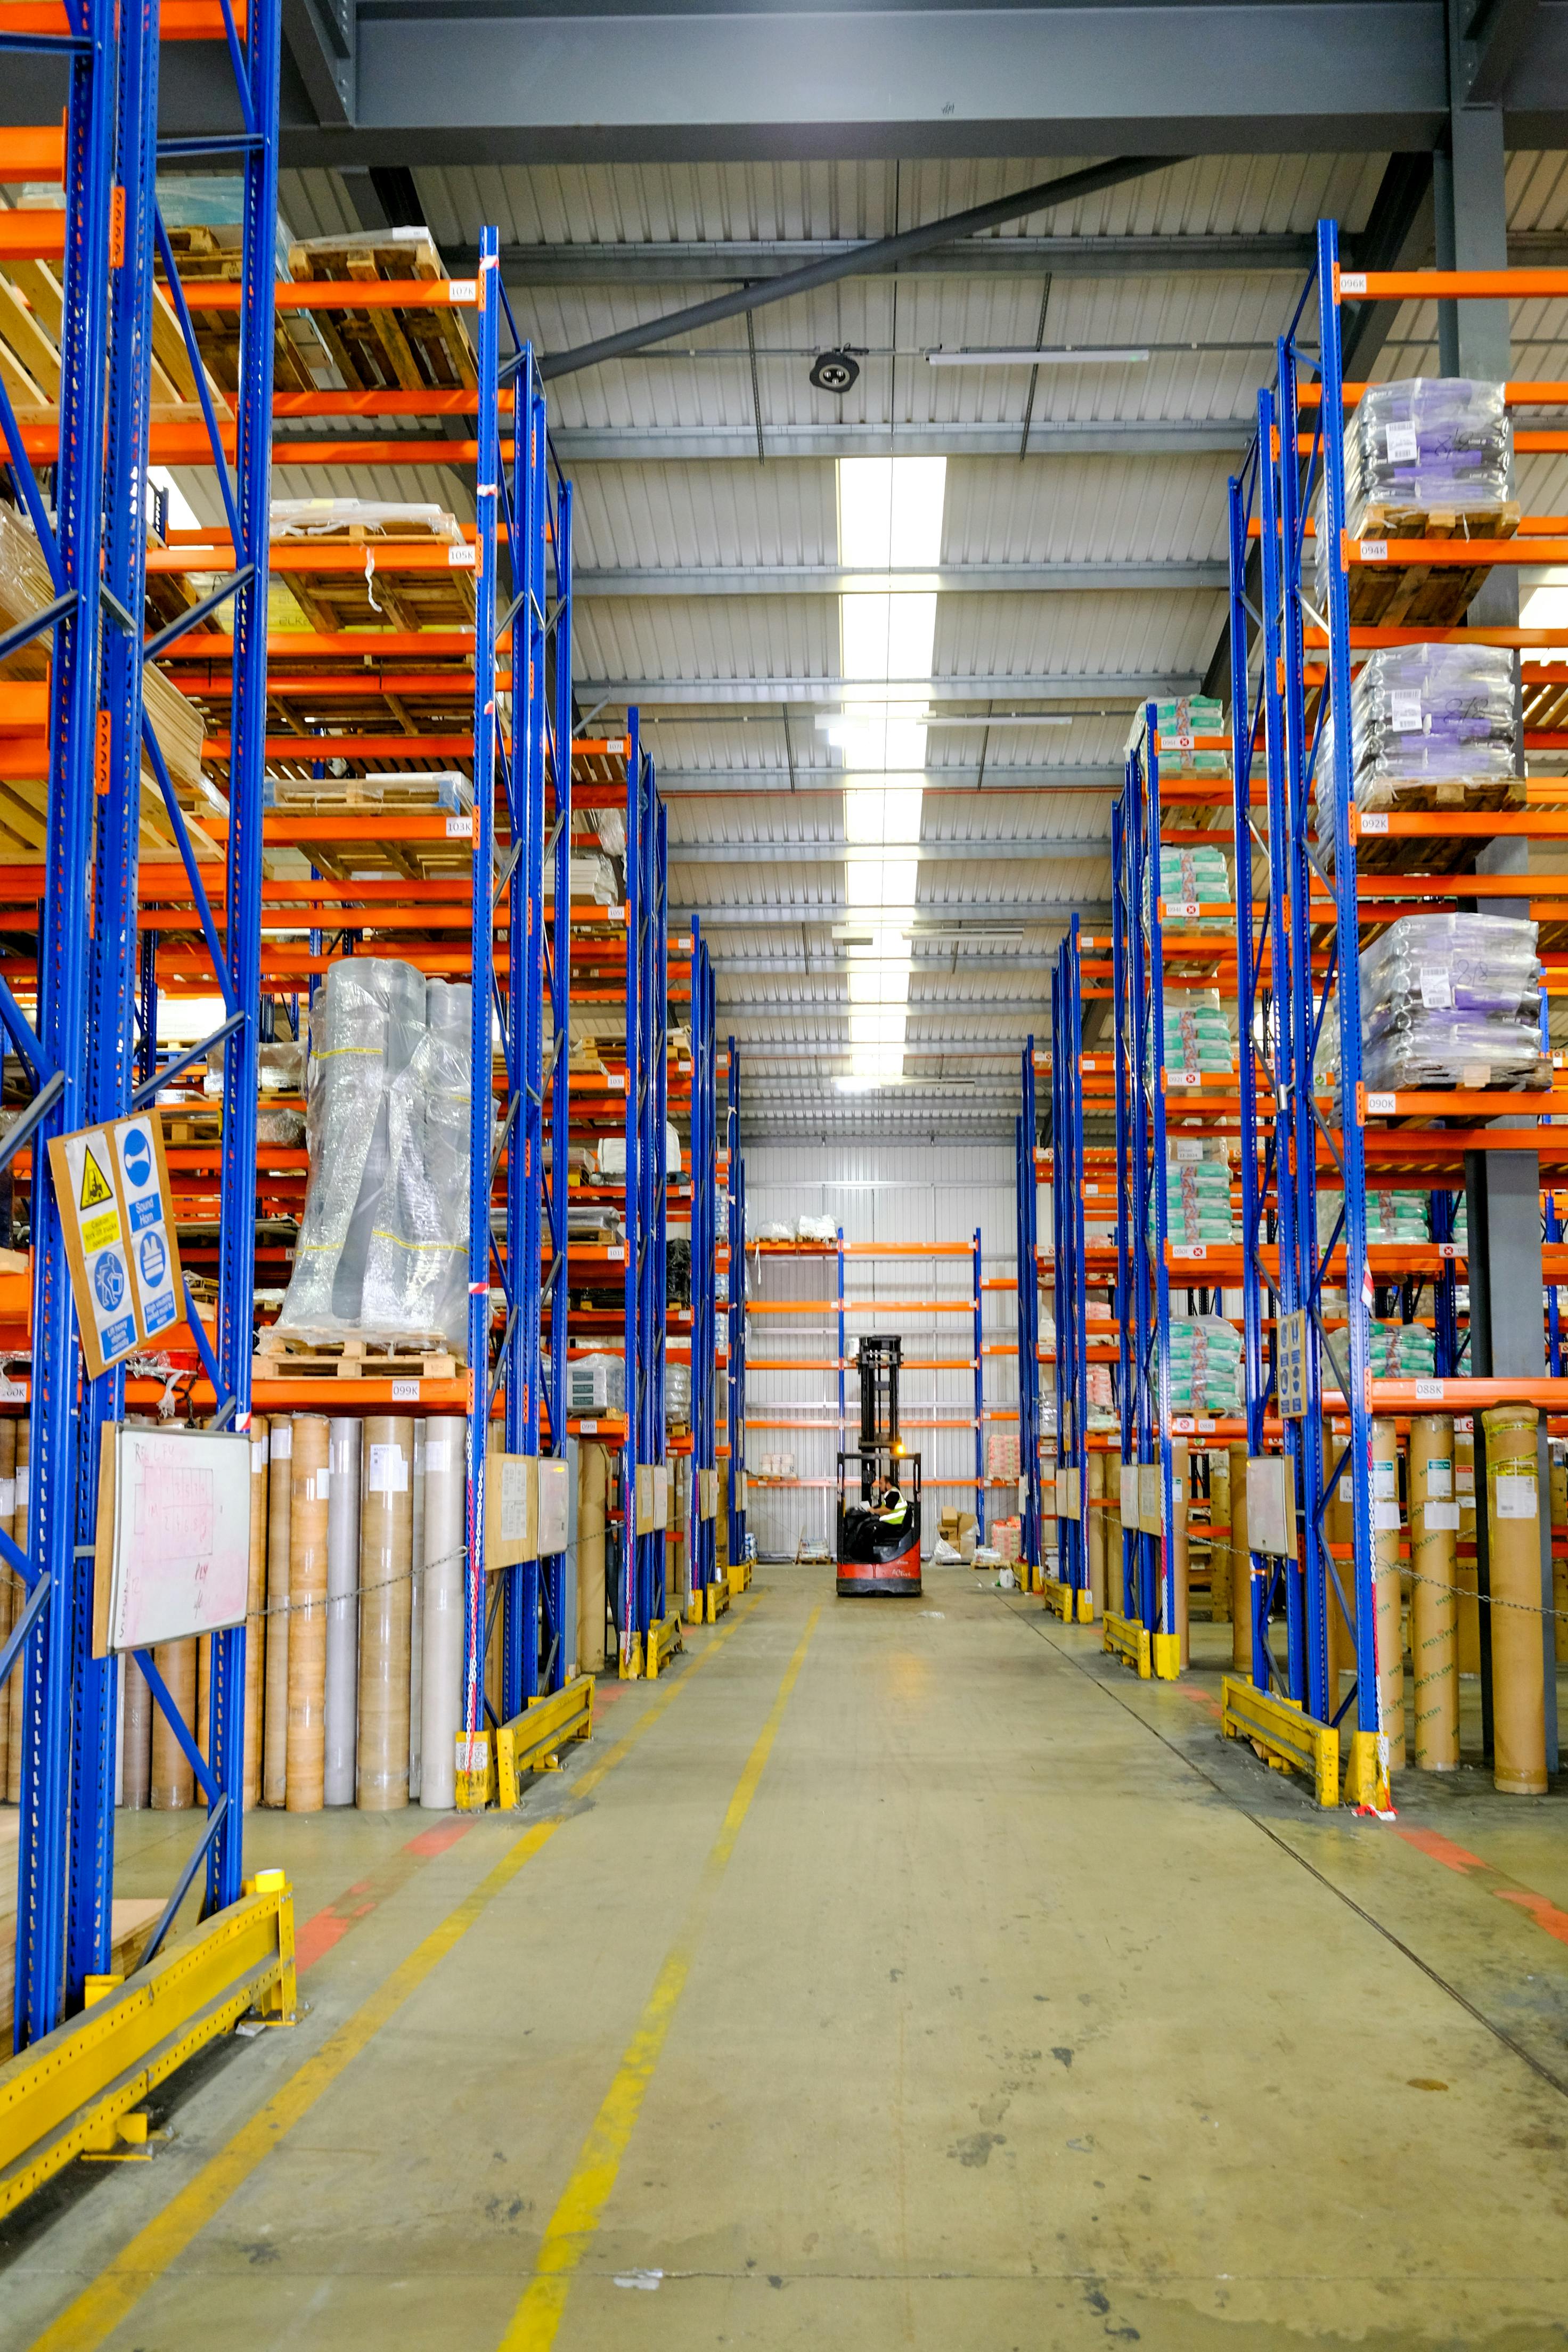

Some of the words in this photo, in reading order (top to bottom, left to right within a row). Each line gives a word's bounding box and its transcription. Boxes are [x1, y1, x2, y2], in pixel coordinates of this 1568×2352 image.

[452, 286, 474, 296] 107K
[451, 551, 473, 559] 105K
[1361, 545, 1386, 555] 094K
[447, 822, 471, 832] 103K
[1362, 819, 1386, 828] 092K
[1369, 1099, 1394, 1108] 090K
[135, 1196, 154, 1215] Sound
[139, 1212, 154, 1226] Horn
[393, 1386, 418, 1395] 099K
[1417, 1384, 1442, 1394] 088K
